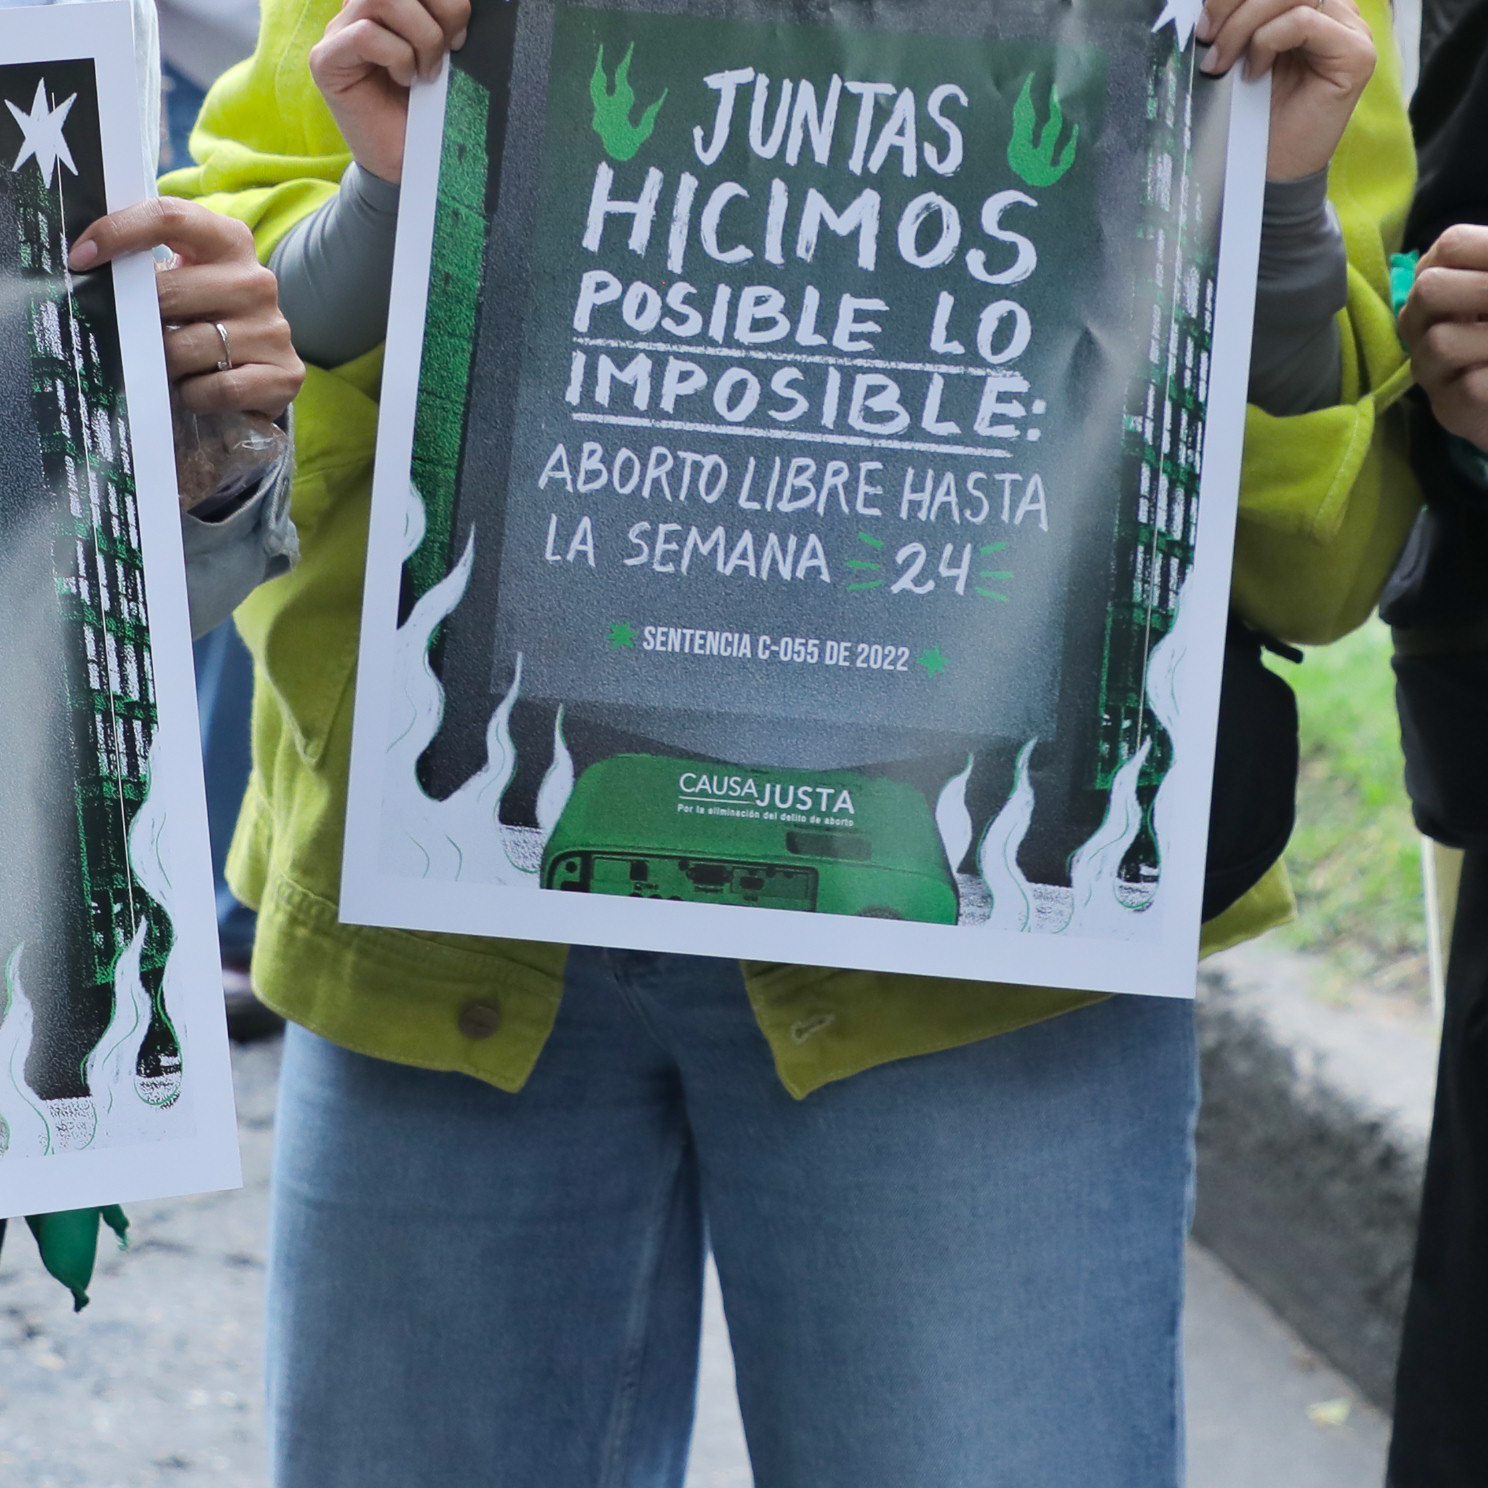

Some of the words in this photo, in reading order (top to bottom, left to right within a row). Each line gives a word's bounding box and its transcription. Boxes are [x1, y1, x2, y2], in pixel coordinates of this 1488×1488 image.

[693, 65, 968, 176] JUNTAS
[581, 161, 1038, 285] HICIMOS
[573, 270, 889, 352] POSIBLE
[930, 291, 1032, 364] LO
[565, 350, 1046, 441] IMPOSIBLE:
[537, 442, 730, 504] ABORTO
[738, 453, 883, 517] LIBRE
[900, 466, 1049, 532] HASTA
[544, 513, 595, 568] LA
[623, 521, 831, 584] SEMANA
[890, 542, 972, 595] 24
[643, 625, 751, 659] SENTENCIA
[757, 634, 819, 665] C-055
[824, 640, 852, 667] DE
[857, 643, 910, 671] 2022
[677, 803, 694, 813] Por
[696, 805, 704, 814] la
[708, 806, 760, 819] eliminación
[763, 811, 777, 820] del
[780, 812, 806, 823] delito
[810, 815, 820, 824] de
[824, 816, 854, 827] aborto
